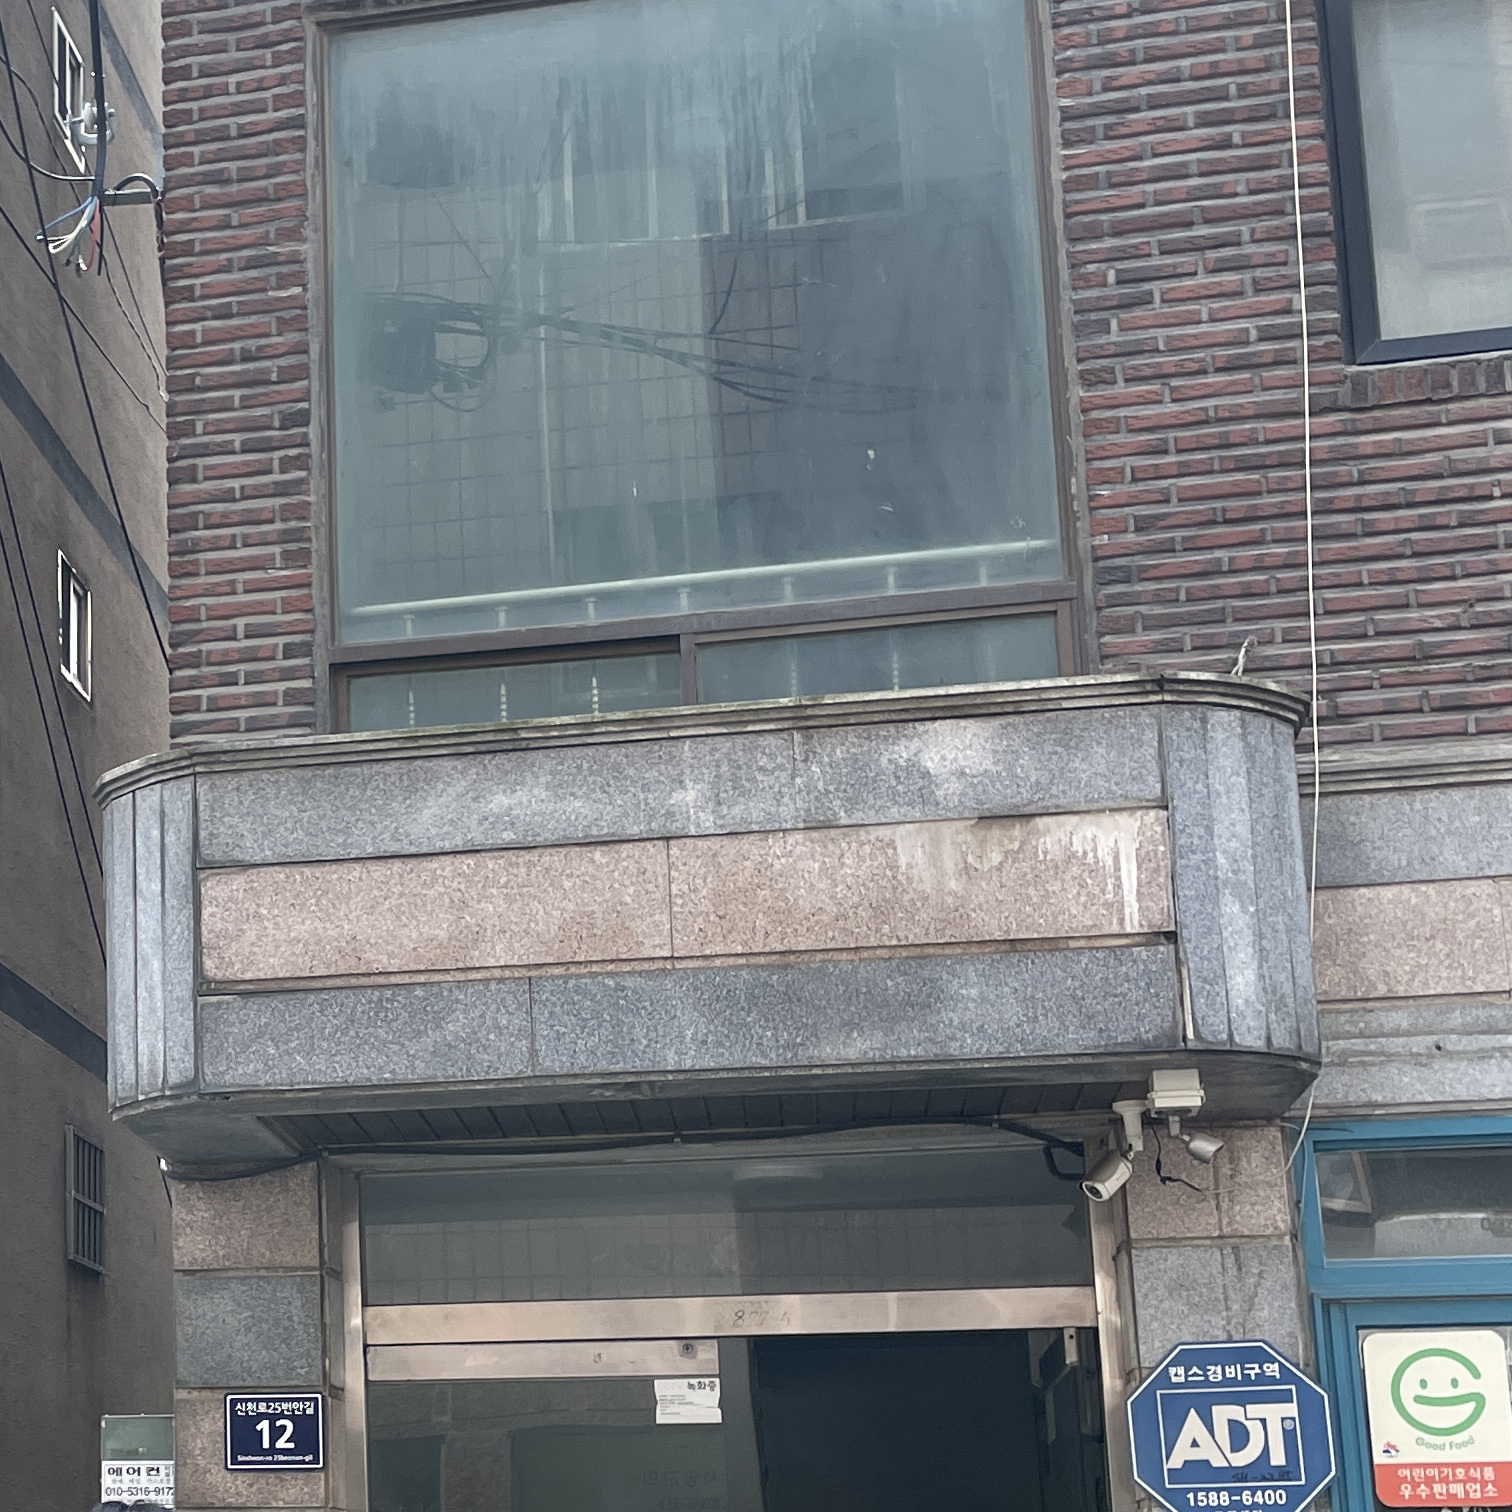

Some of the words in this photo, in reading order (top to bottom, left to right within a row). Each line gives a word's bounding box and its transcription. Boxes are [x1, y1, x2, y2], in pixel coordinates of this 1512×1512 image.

[1168, 1362, 1281, 1383] 캡스경비구역
[235, 1401, 315, 1416] 신천로25번안길
[255, 1418, 296, 1449] 12
[1165, 1402, 1298, 1470] ADT
[1416, 1436, 1446, 1451] Good
[107, 1466, 161, 1477] 에어컨
[1397, 1466, 1496, 1482] 어린이기호식품
[1185, 1489, 1288, 1507] 1588-6400
[1398, 1481, 1499, 1500] 우수판매업소
